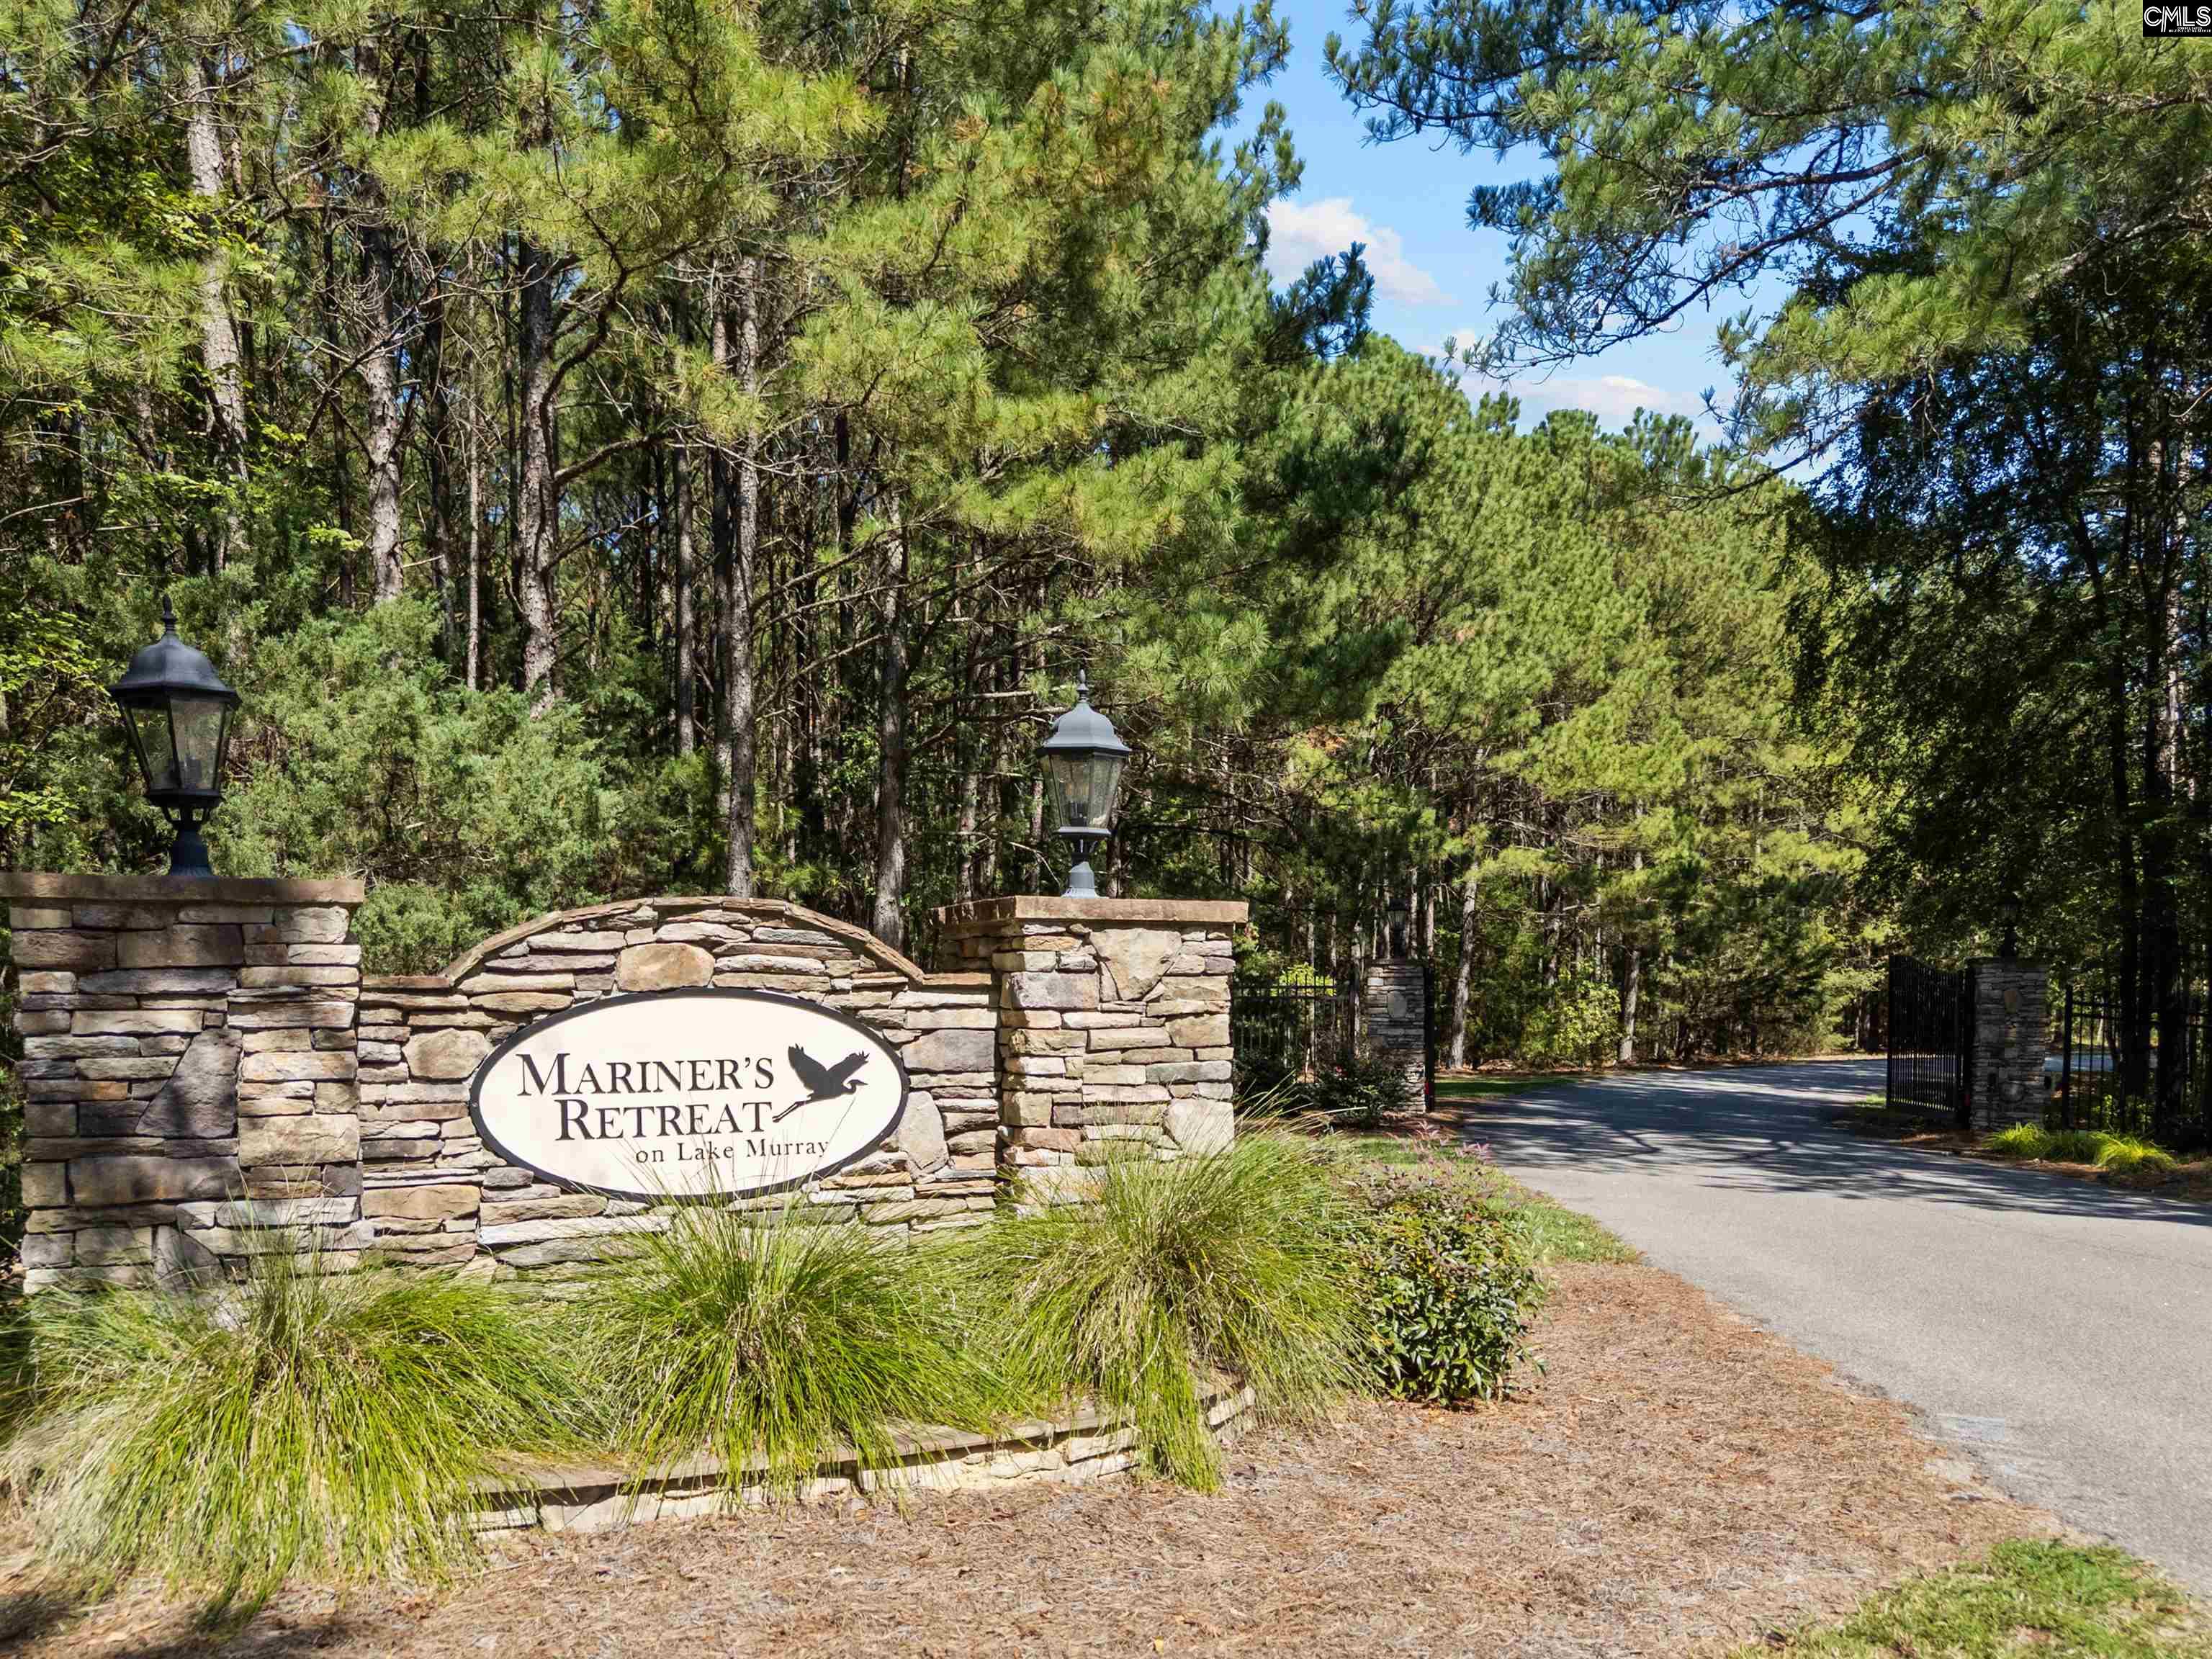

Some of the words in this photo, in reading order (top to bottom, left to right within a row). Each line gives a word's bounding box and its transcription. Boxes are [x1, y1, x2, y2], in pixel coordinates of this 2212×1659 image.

[516, 1053, 774, 1096] MARINER'S
[554, 1099, 773, 1141] RETREAT
[636, 1149, 664, 1163] on
[677, 1141, 734, 1161] Lake
[746, 1138, 829, 1158] Murray
